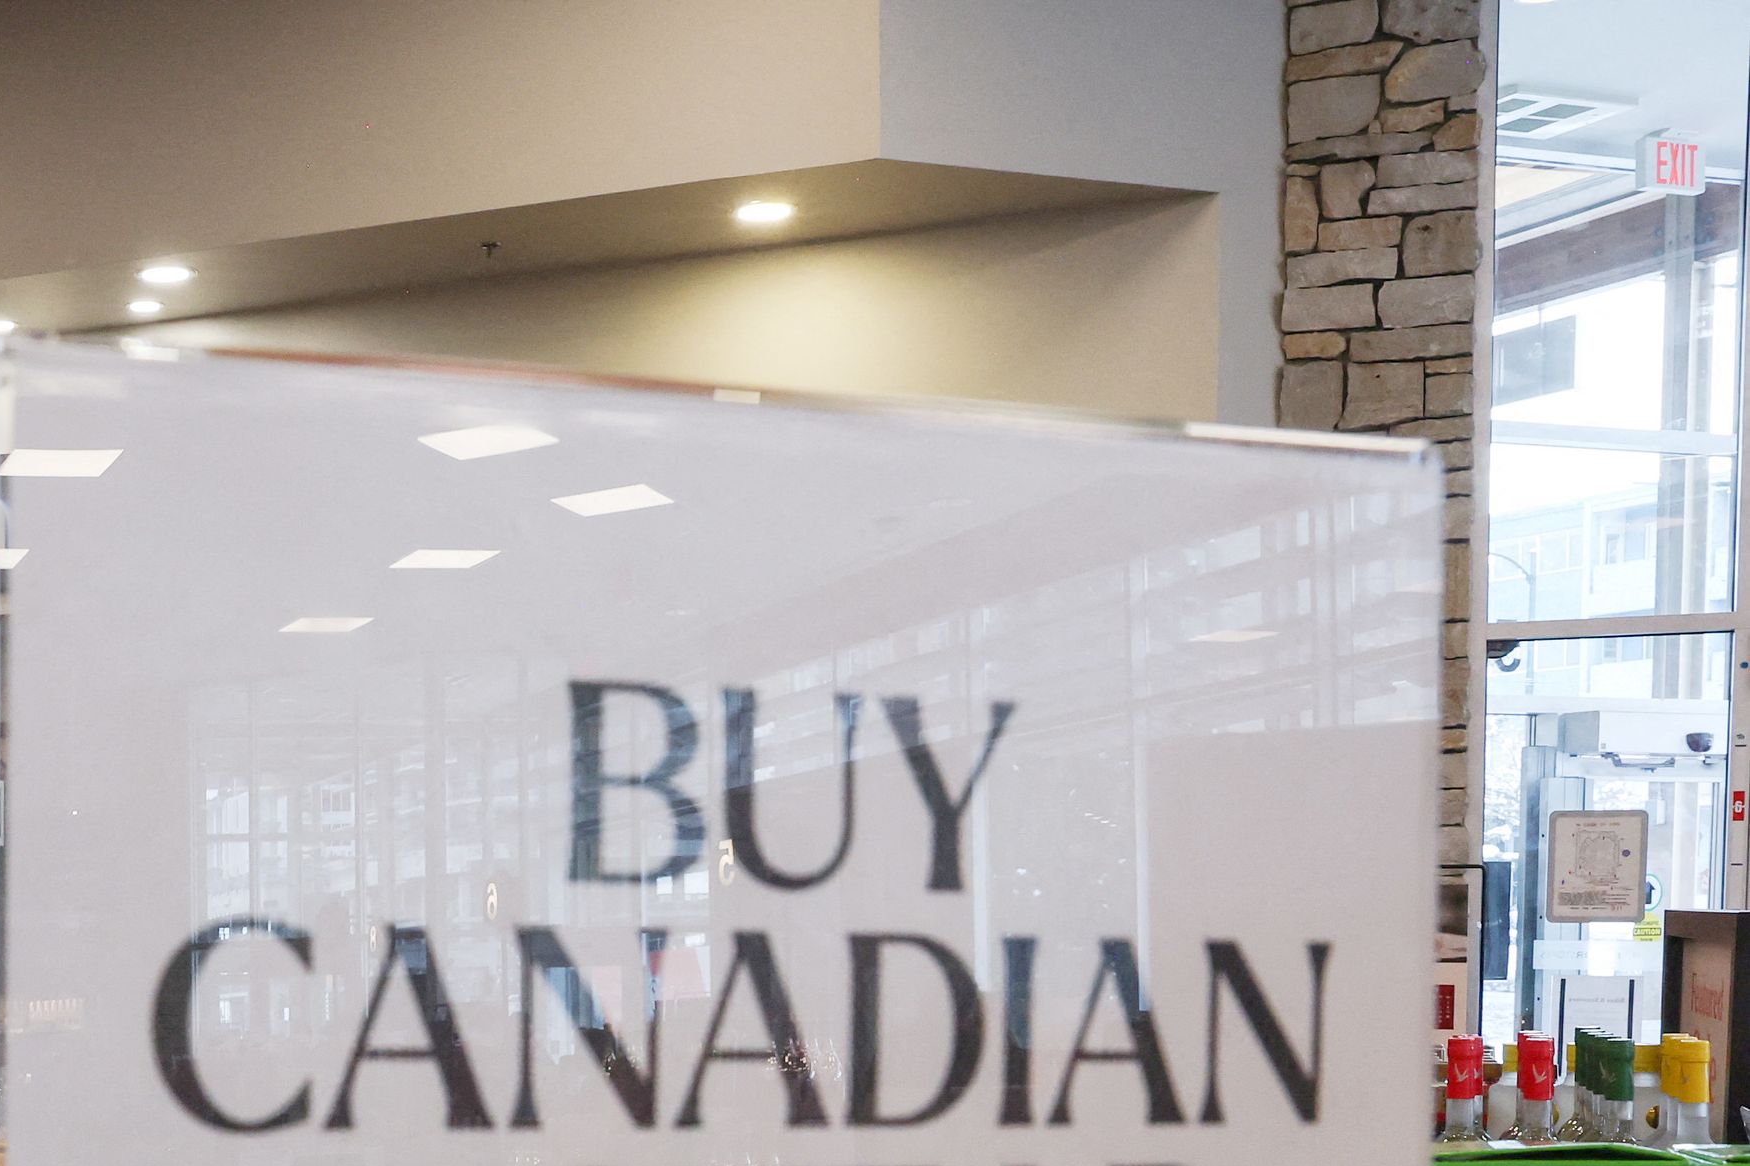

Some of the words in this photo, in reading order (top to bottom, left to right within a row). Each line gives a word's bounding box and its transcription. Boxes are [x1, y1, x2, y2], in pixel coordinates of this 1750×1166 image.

[1656, 141, 1698, 188] EXIT
[566, 678, 1018, 893] BUY
[150, 914, 1333, 1136] CANADIAN
